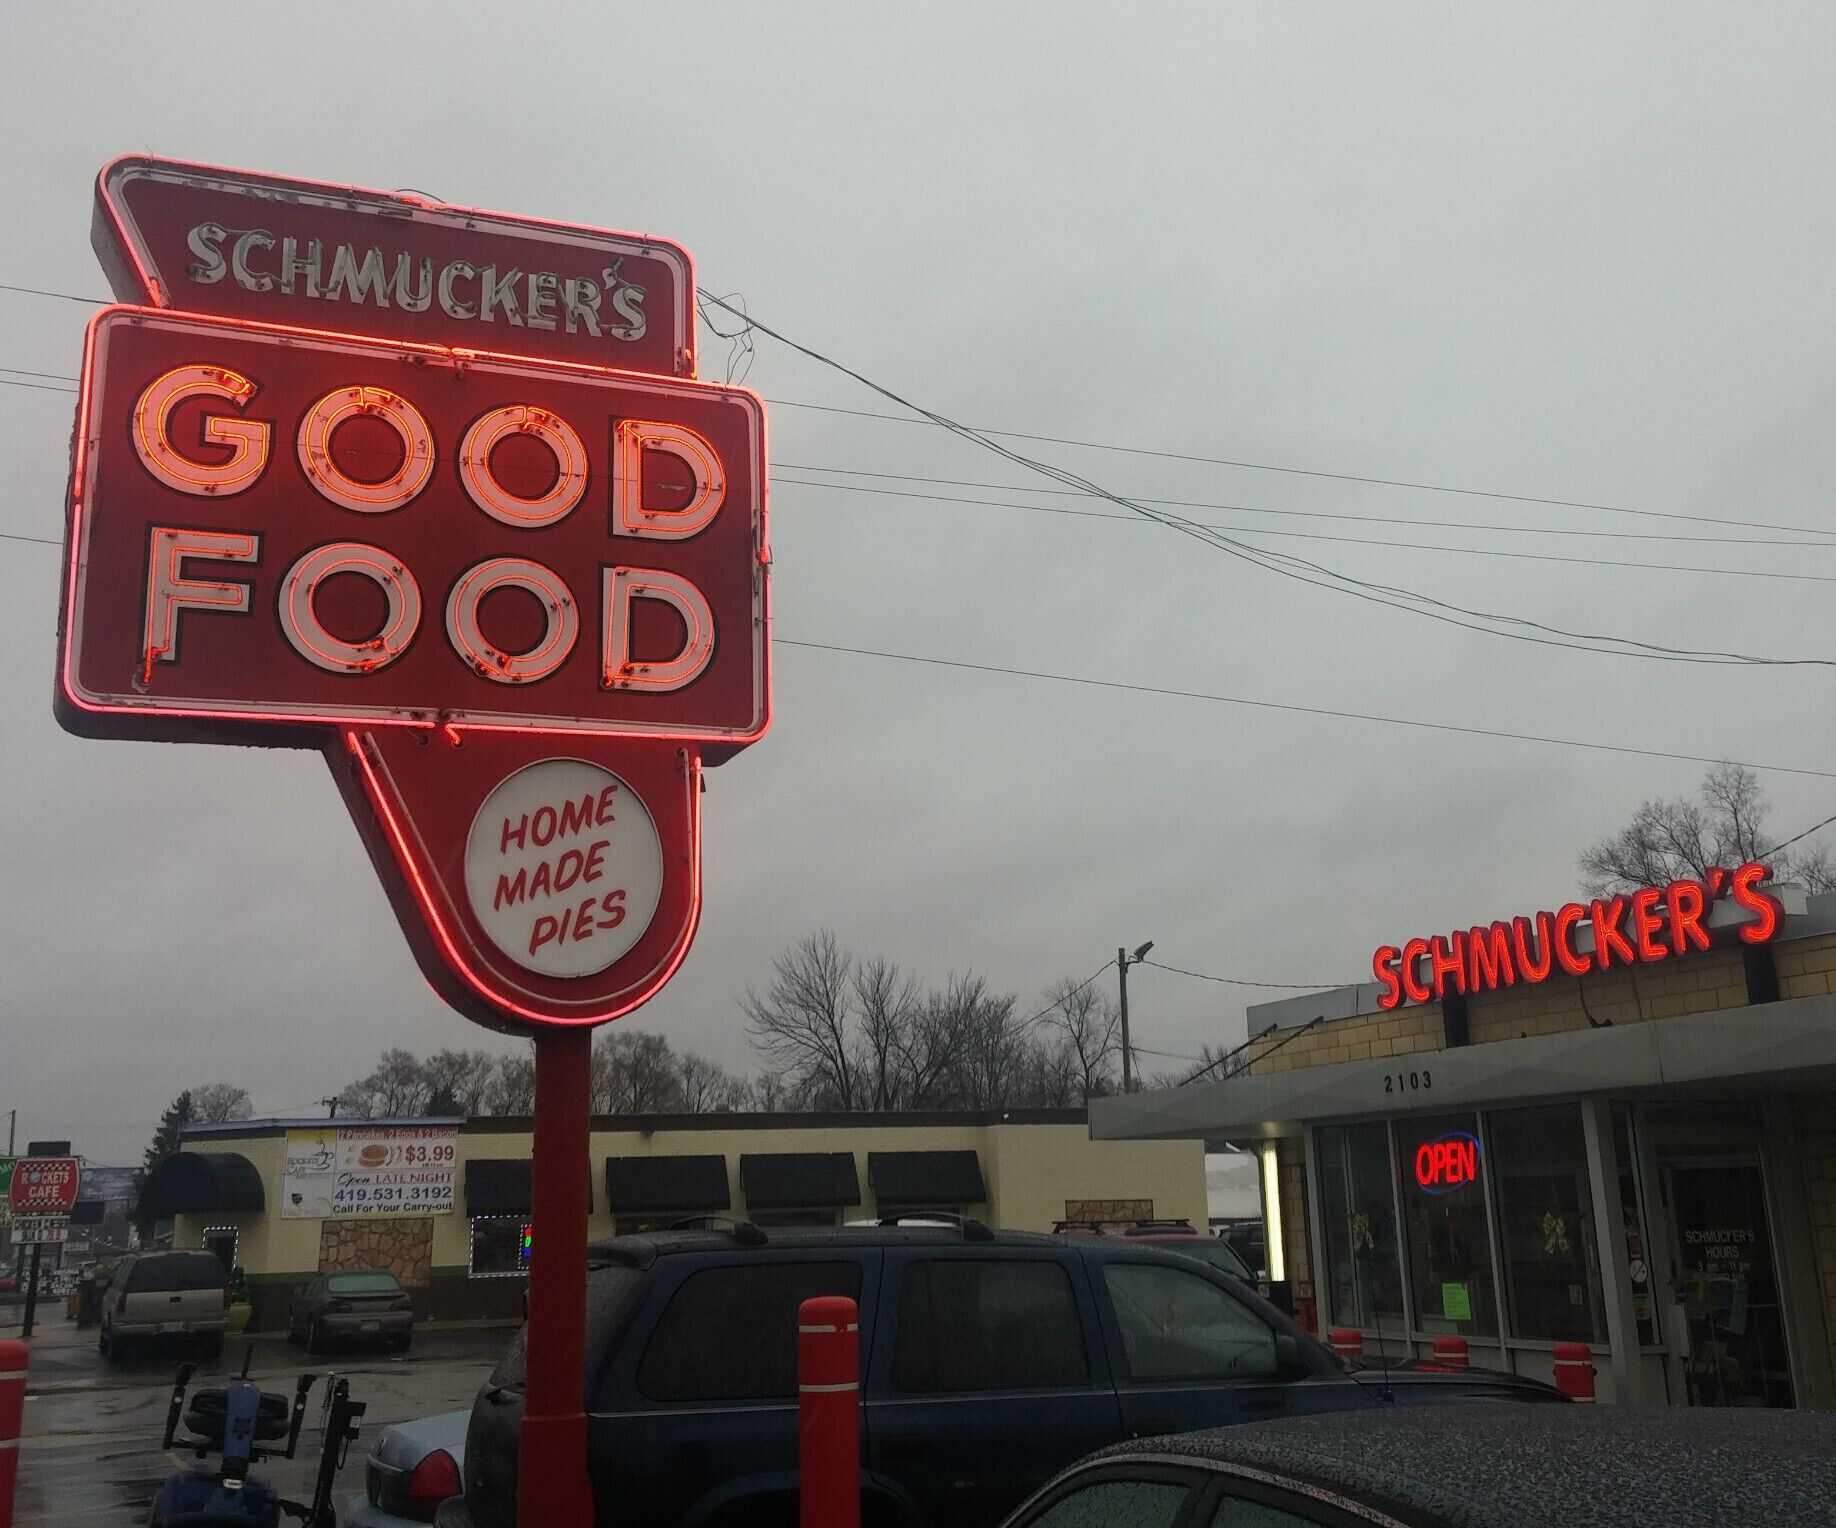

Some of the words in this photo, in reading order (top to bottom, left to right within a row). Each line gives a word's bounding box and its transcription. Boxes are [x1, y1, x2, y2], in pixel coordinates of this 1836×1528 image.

[186, 221, 648, 341] SCHMUCKER'S
[132, 364, 726, 541] GOOD
[142, 526, 715, 692] FOOD
[500, 785, 618, 855] HOME
[493, 840, 611, 912] MADE
[528, 889, 626, 957] PIES
[1373, 862, 1785, 1011] SCHMUCKER'S
[1384, 1070, 1433, 1093] 2103
[405, 1144, 454, 1165] $3.99
[1416, 1141, 1475, 1186] OPEN
[29, 1185, 60, 1198] CAFE
[335, 1186, 452, 1201] 419.531.3192
[337, 1172, 370, 1187] Open
[376, 1173, 407, 1184] LATE
[410, 1172, 453, 1184] NIGHT
[333, 1204, 354, 1214] Call
[356, 1204, 373, 1213] For
[377, 1203, 400, 1213] Your
[403, 1202, 452, 1213] Carry-out
[1705, 1246, 1739, 1259] HOURS
